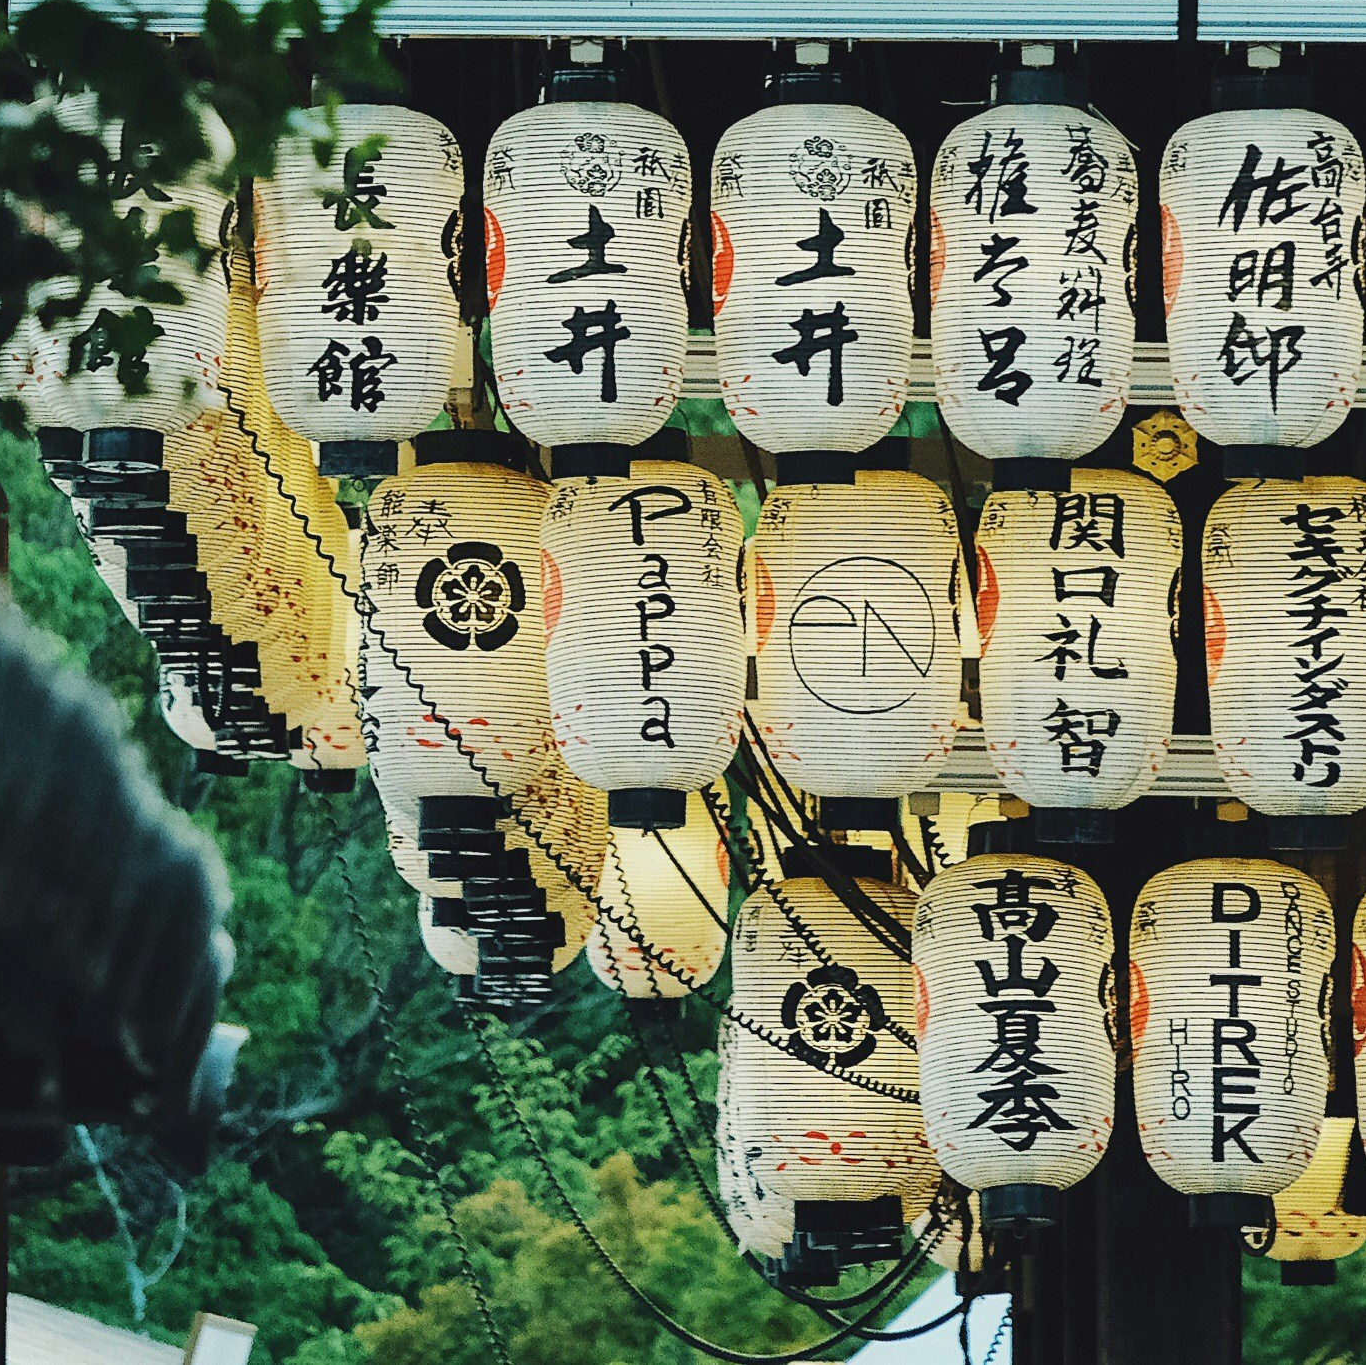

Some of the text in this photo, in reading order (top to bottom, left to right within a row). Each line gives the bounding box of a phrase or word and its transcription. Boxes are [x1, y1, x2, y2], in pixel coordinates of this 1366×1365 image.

[543, 203, 632, 404] 土井
[770, 206, 860, 407] 土井
[696, 478, 726, 588] 有限会社
[1033, 491, 1130, 779] 関口礼智
[1168, 1018, 1192, 1122] HIRO
[1209, 881, 1264, 1164] DITREK
[1280, 881, 1304, 1095] DANCE STUDIO
